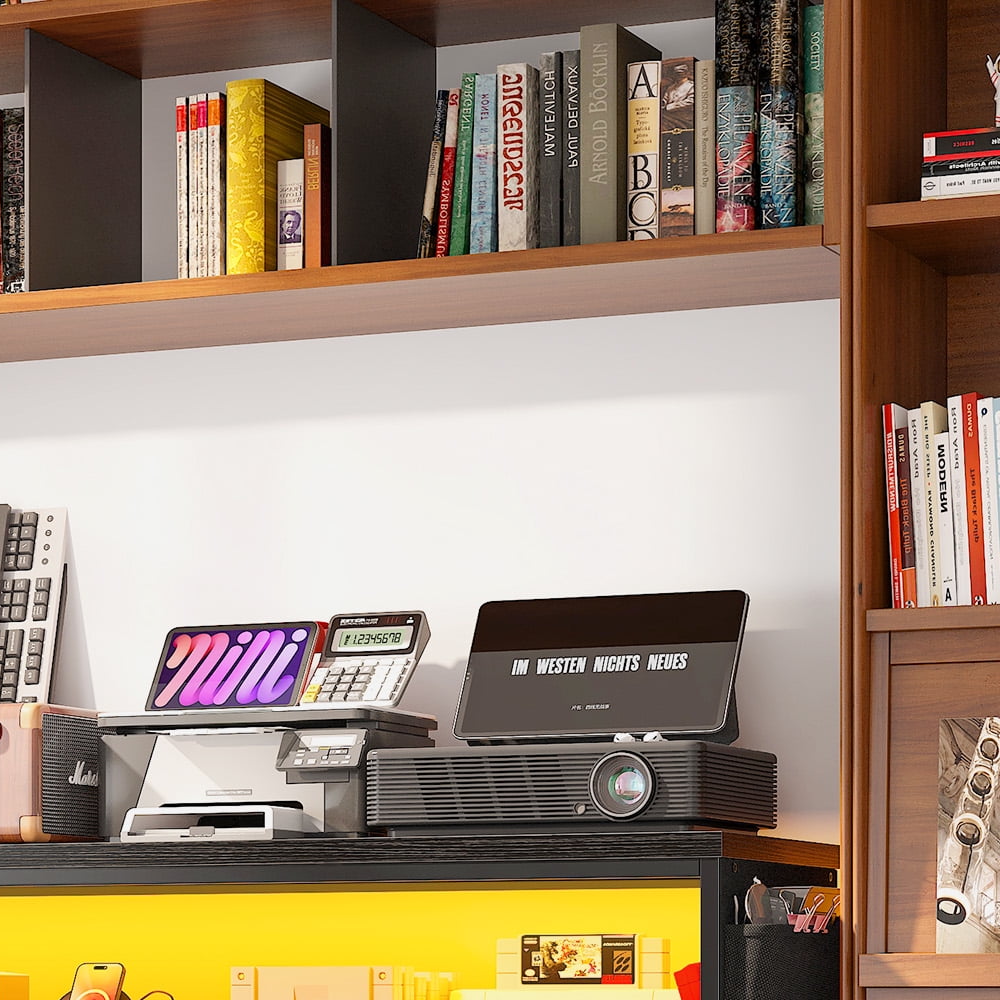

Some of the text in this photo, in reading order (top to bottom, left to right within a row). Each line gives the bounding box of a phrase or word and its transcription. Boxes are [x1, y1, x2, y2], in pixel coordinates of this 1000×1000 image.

[811, 31, 820, 71] SOCIETY
[589, 118, 608, 185] ARNOLD
[631, 155, 653, 191] B
[762, 208, 793, 225] K-Z
[511, 653, 689, 676] IM WESTEN NICHTS NEUES
